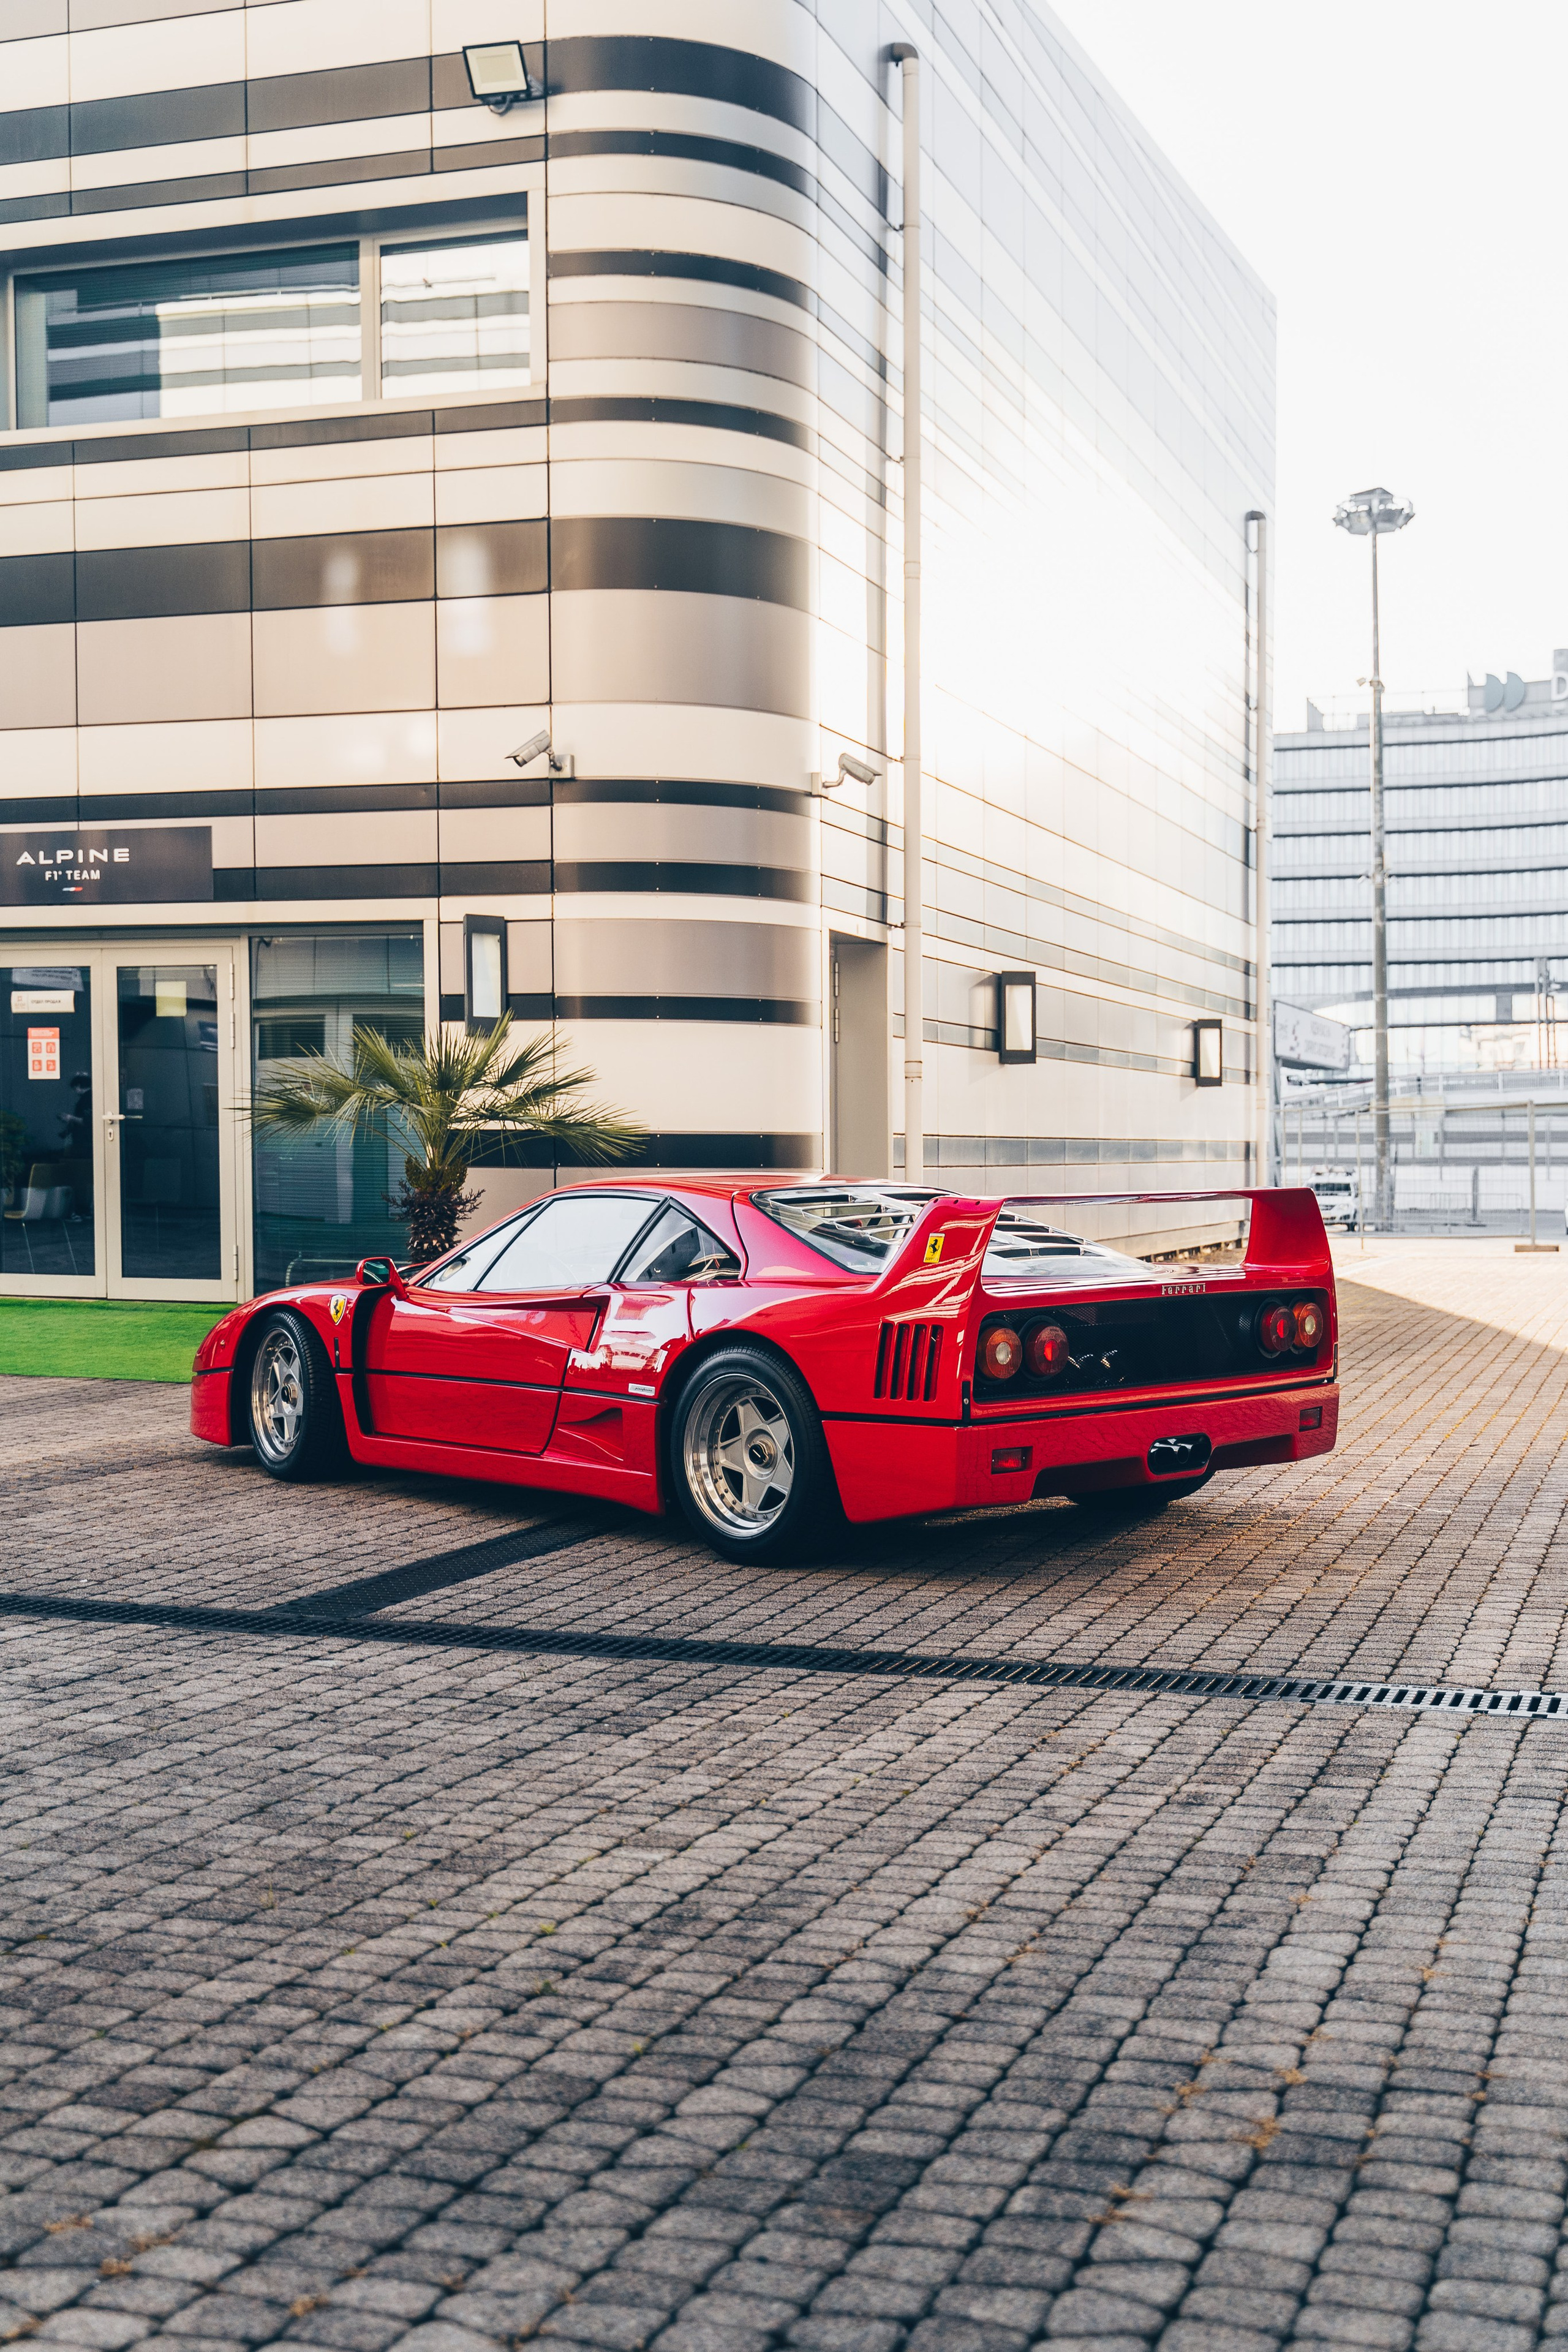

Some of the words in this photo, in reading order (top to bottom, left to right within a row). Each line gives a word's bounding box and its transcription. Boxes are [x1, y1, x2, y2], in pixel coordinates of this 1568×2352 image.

[16, 848, 130, 865] ALPINE
[65, 869, 100, 881] TEAM
[1161, 1283, 1205, 1295] Ferrari
